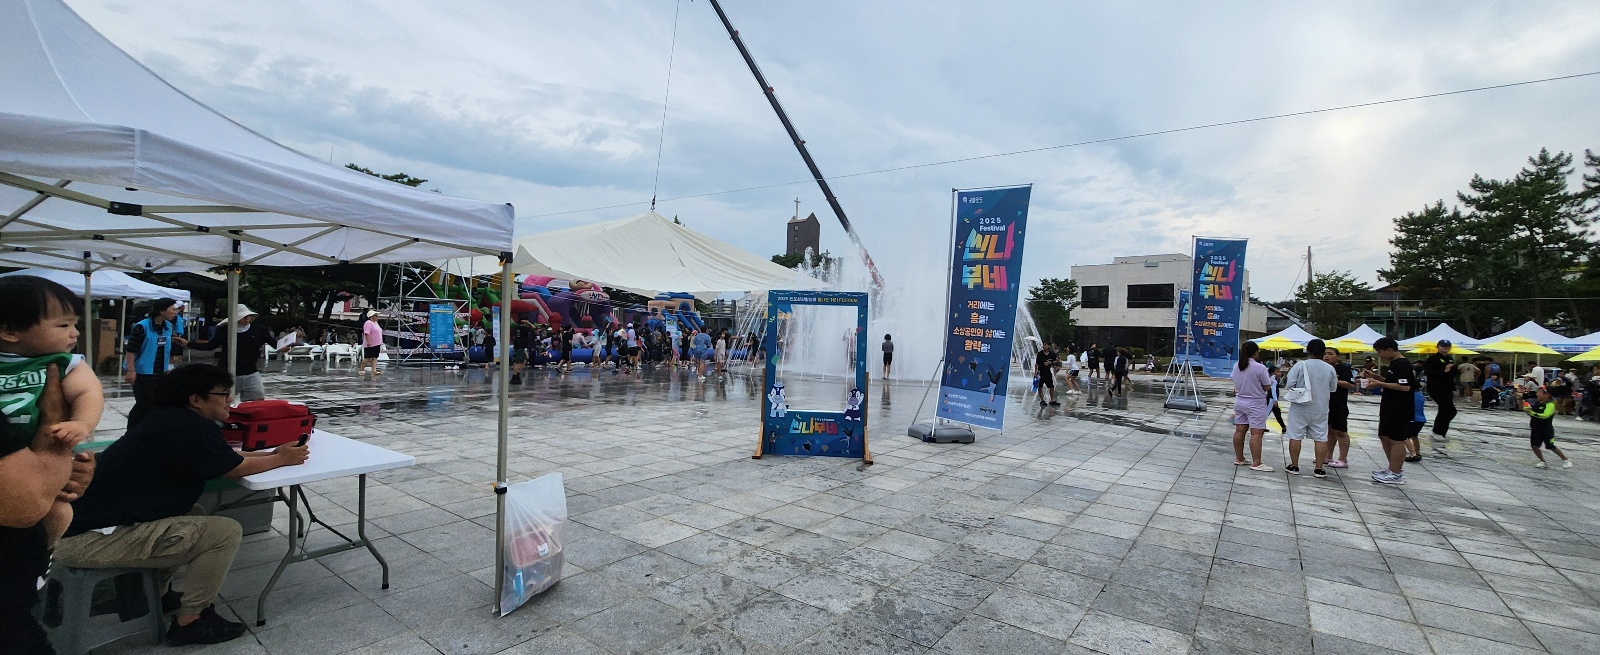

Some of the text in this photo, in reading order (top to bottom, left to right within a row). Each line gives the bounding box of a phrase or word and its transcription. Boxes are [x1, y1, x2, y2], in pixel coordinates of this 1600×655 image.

[979, 217, 1002, 225] 2025
[963, 220, 1015, 261] 씬나
[962, 264, 1008, 291] 부네
[1199, 259, 1236, 283] 씬나
[1199, 283, 1233, 300] 부네
[967, 300, 995, 311] 거리에는
[970, 312, 989, 325] 흥을!
[953, 326, 1006, 339] 소상공인의 삶에는
[964, 339, 991, 353] 활력을!
[789, 416, 839, 435] 씬나부네
